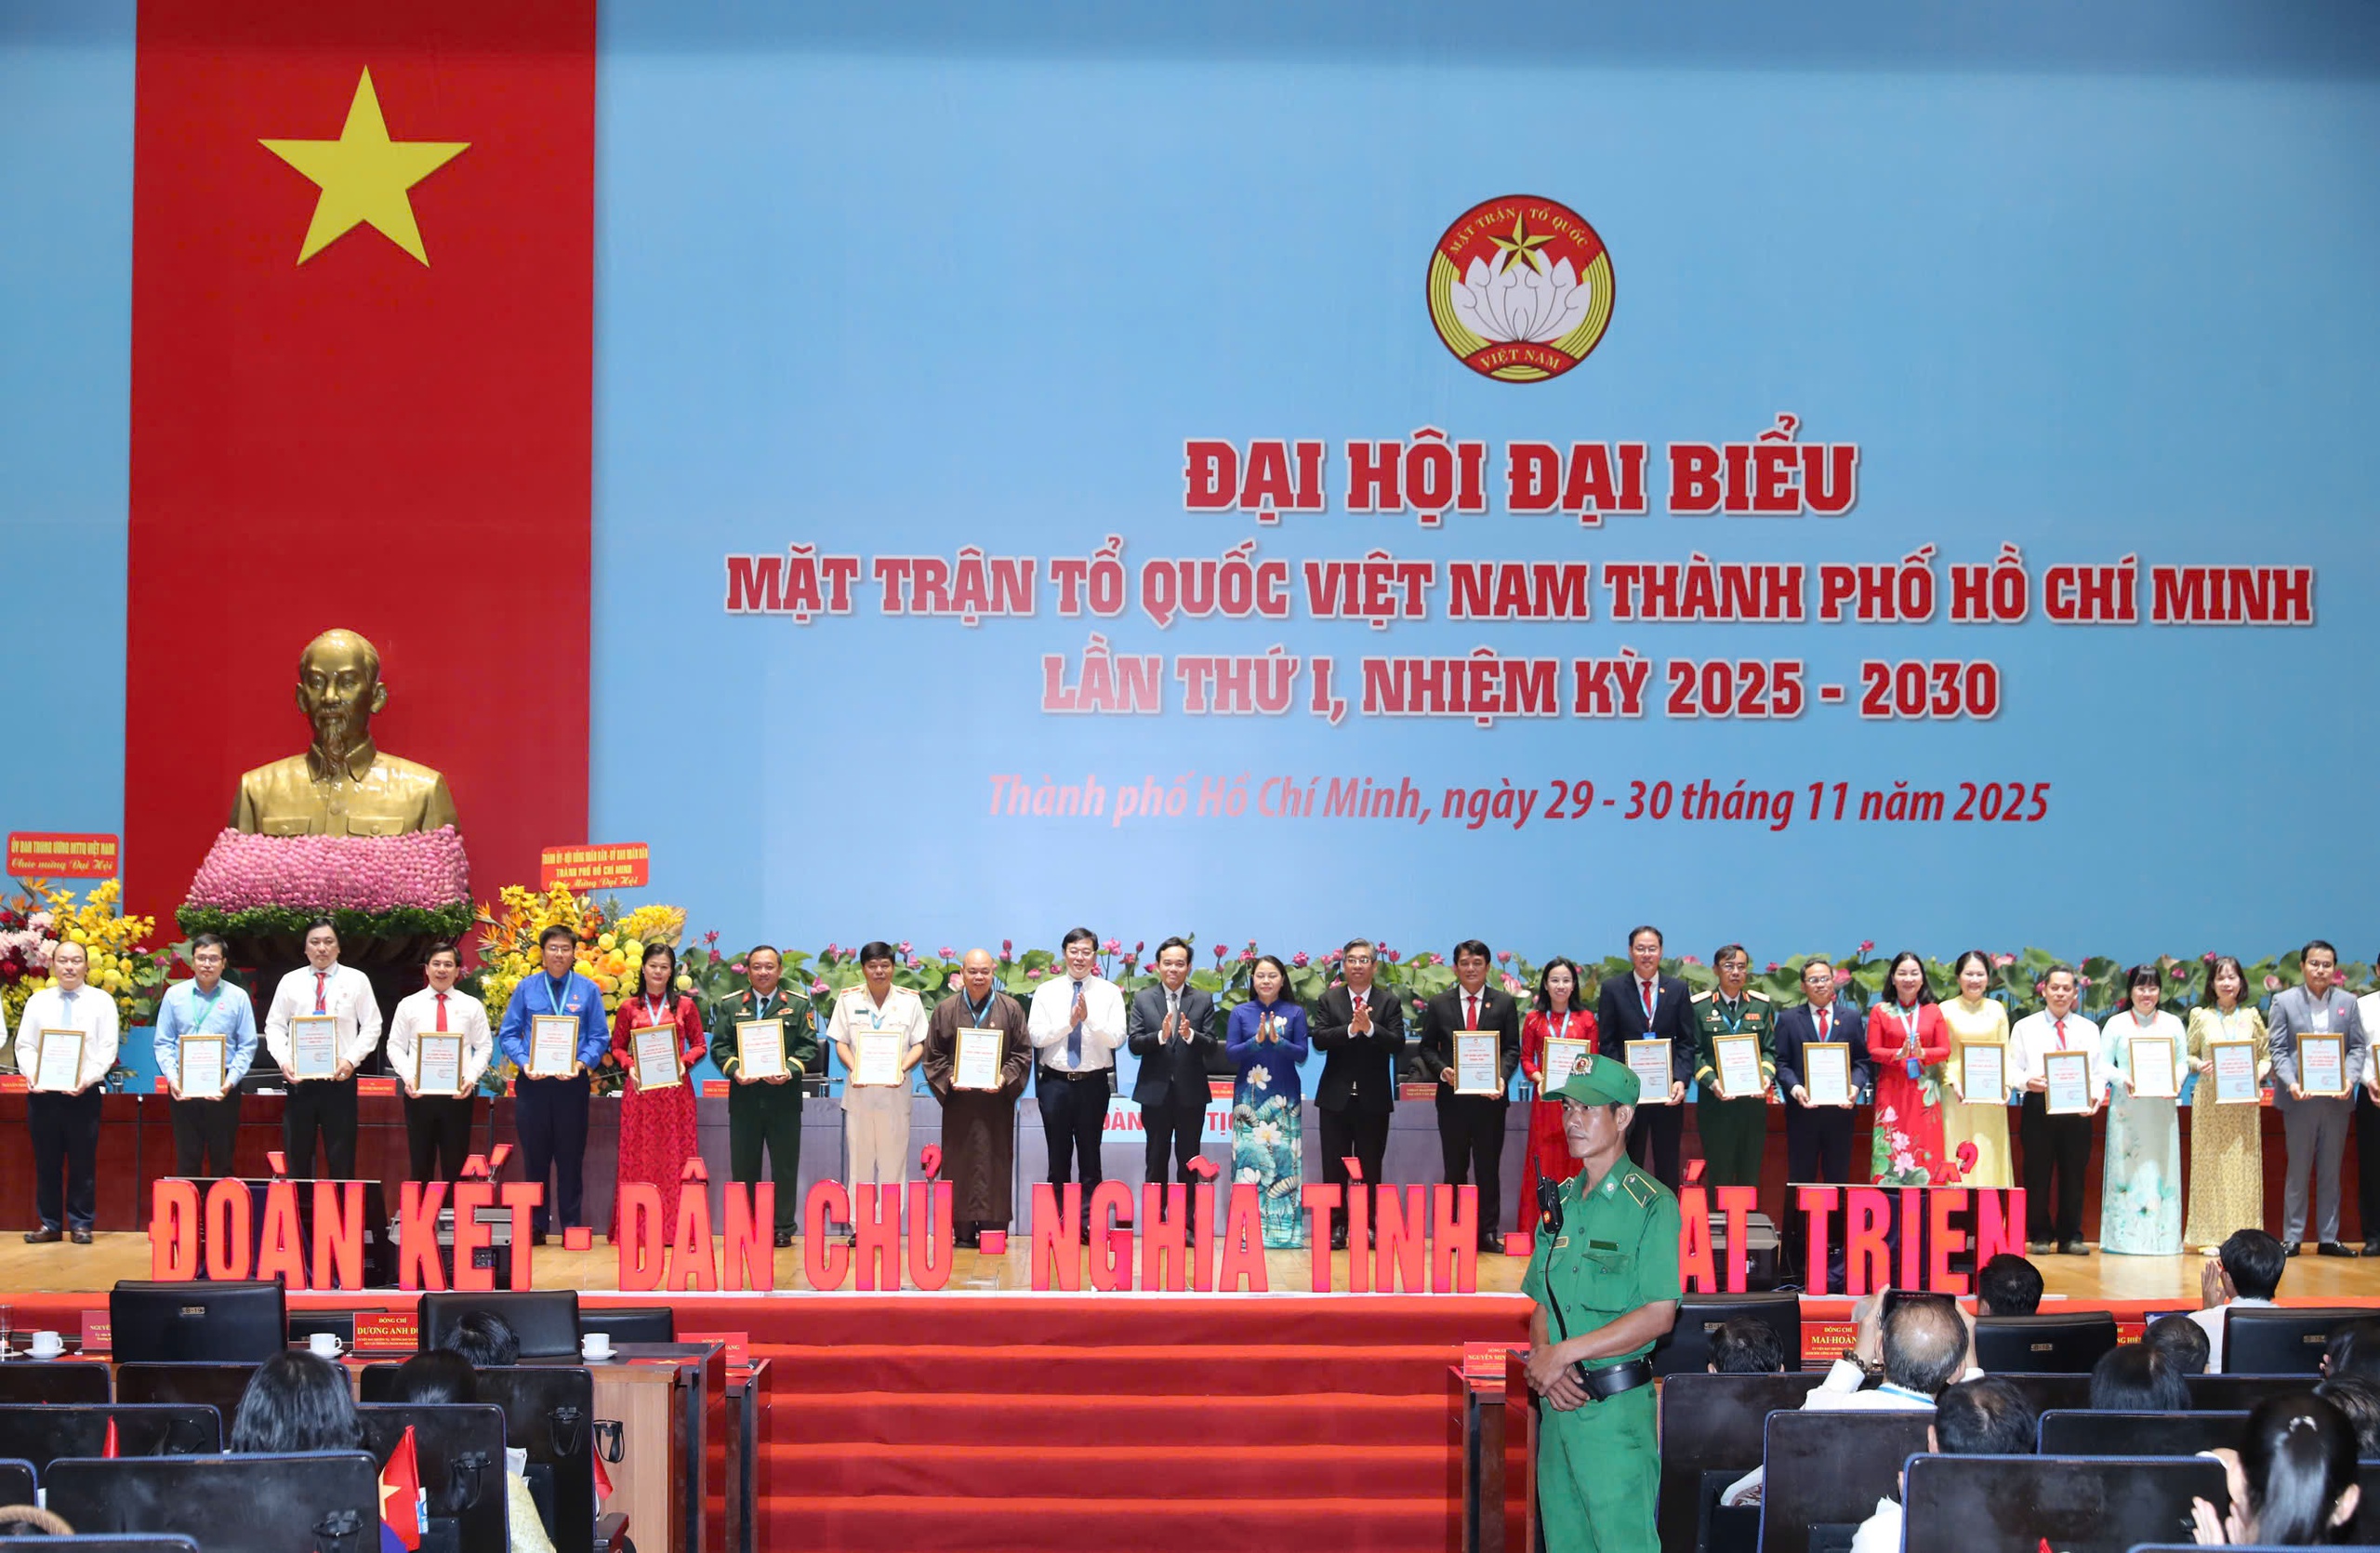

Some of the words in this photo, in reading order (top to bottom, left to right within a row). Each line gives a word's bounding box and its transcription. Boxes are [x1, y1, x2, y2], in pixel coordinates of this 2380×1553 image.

[1449, 227, 1475, 255] MẶT
[1475, 206, 1516, 230] TRẬN
[1529, 206, 1551, 222] TỔ
[1552, 216, 1588, 249] QUỐC
[1480, 348, 1520, 369] VIỆT
[1524, 349, 1562, 369] NAM
[1184, 440, 1324, 523] ĐẠI
[1345, 427, 1486, 524] HỘI
[1506, 442, 1646, 524] ĐẠI
[1668, 414, 1858, 514] BIỂU
[725, 545, 860, 623] MẶT
[873, 547, 1036, 625] TRẬN
[1050, 536, 1124, 616] TỔ
[1142, 540, 1289, 627] QUỐC
[1303, 550, 1434, 628] VIỆT
[1448, 562, 1589, 619] NAM
[1604, 553, 1804, 620] THÀNH
[1818, 545, 1934, 621] PHỐ
[1950, 543, 2028, 621] HỒ
[2043, 554, 2137, 622] CHÍ
[2151, 566, 2311, 623] MINH
[1043, 634, 1161, 711] LẦN
[1176, 646, 1300, 712] THỨ
[1311, 657, 1345, 723] I,
[1362, 647, 1558, 725] NHIỆM
[1573, 648, 1650, 715] KỲ
[1667, 660, 1803, 717] 2025
[1820, 686, 1844, 700] -
[1860, 661, 1999, 718] 2030
[989, 774, 1105, 816] Thành
[1113, 772, 1194, 827] phố
[1197, 776, 1250, 817] Hồ
[1258, 776, 1321, 817] Chí
[1323, 777, 1432, 825] Minh,
[1442, 778, 1538, 830] ngày
[1544, 780, 1595, 819] 29
[1623, 780, 1674, 820] 30
[1681, 779, 1795, 831] tháng
[1808, 781, 1848, 821] 11
[1859, 781, 1947, 821] năm
[1952, 781, 2051, 822] 2025
[149, 1151, 365, 1292] ĐOÀN
[399, 1144, 544, 1291] KẾT
[618, 1157, 775, 1292] DÂN
[803, 1143, 954, 1292] CHỦ
[1031, 1155, 1269, 1293] NGHĨA
[1302, 1157, 1478, 1293] TÌNH
[1678, 1159, 1757, 1294] ÁT
[1796, 1140, 2028, 1296] TRIỂN
[1831, 1334, 1858, 1345] HOÀN
